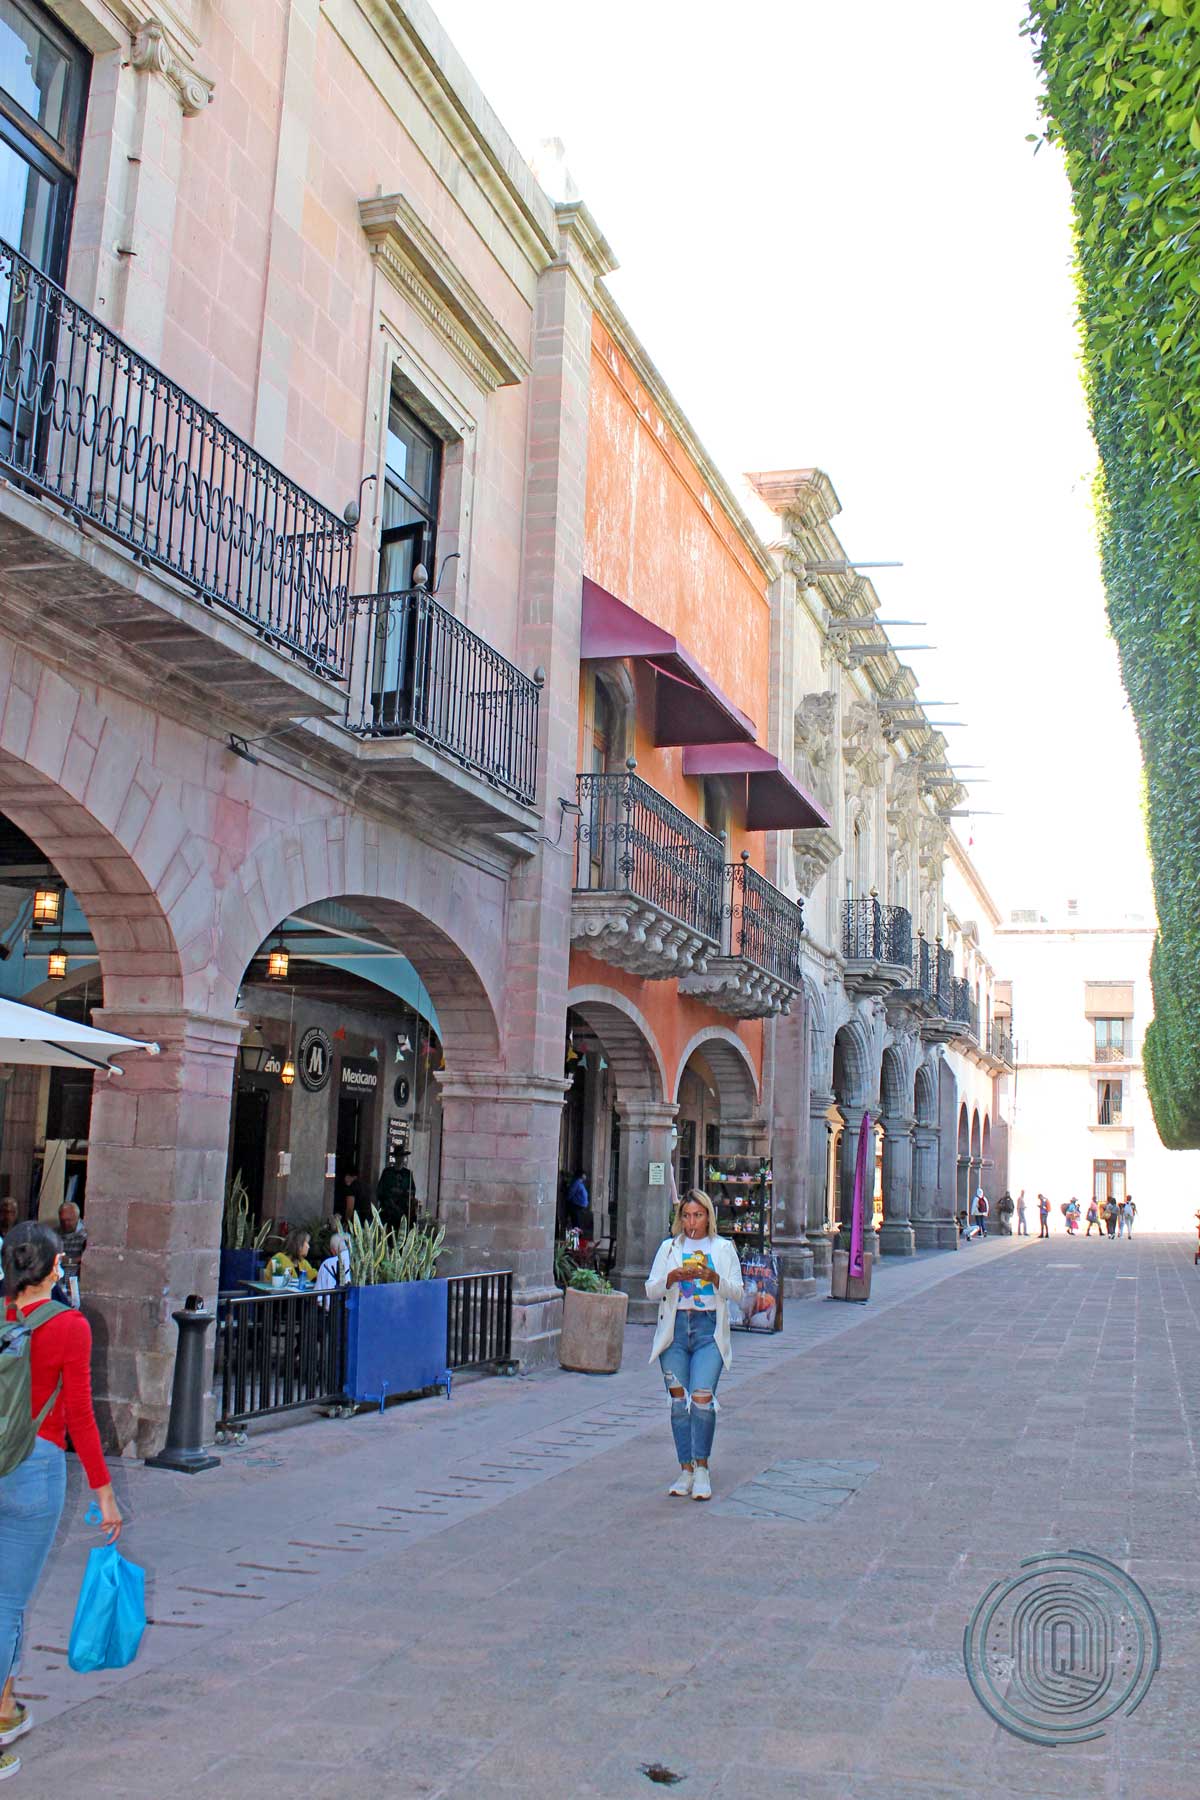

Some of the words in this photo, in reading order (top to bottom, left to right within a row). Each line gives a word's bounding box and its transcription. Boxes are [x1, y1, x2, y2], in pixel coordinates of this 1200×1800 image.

[308, 1046, 323, 1075] M
[342, 1067, 377, 1086] Mexicano
[742, 1267, 772, 1278] LATTE
